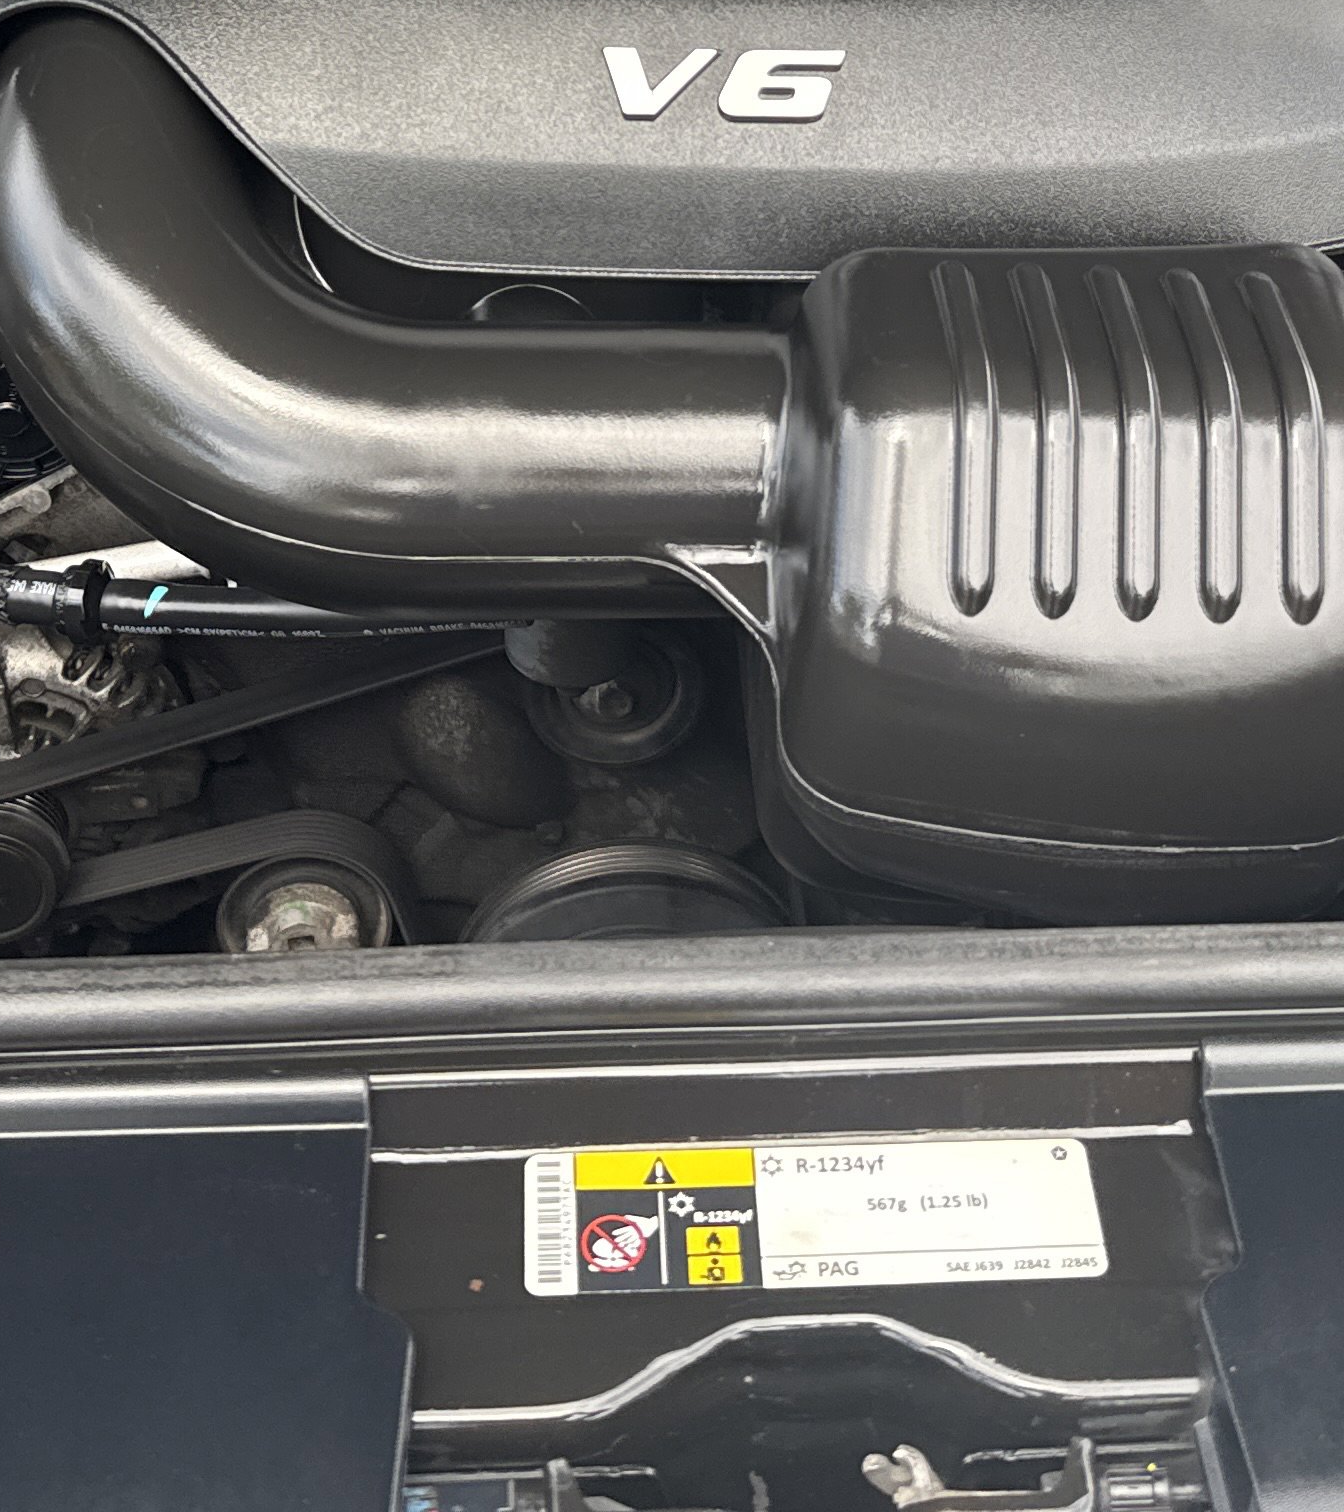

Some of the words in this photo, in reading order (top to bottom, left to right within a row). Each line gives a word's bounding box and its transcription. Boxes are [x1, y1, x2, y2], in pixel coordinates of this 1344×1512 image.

[602, 46, 848, 124] V6
[796, 1154, 884, 1175] R-1234yf
[867, 1197, 908, 1213] 567g
[920, 1194, 962, 1212] (1.25
[966, 1192, 989, 1210] lb)
[818, 1260, 860, 1277] PAG
[946, 1261, 971, 1273] SAE
